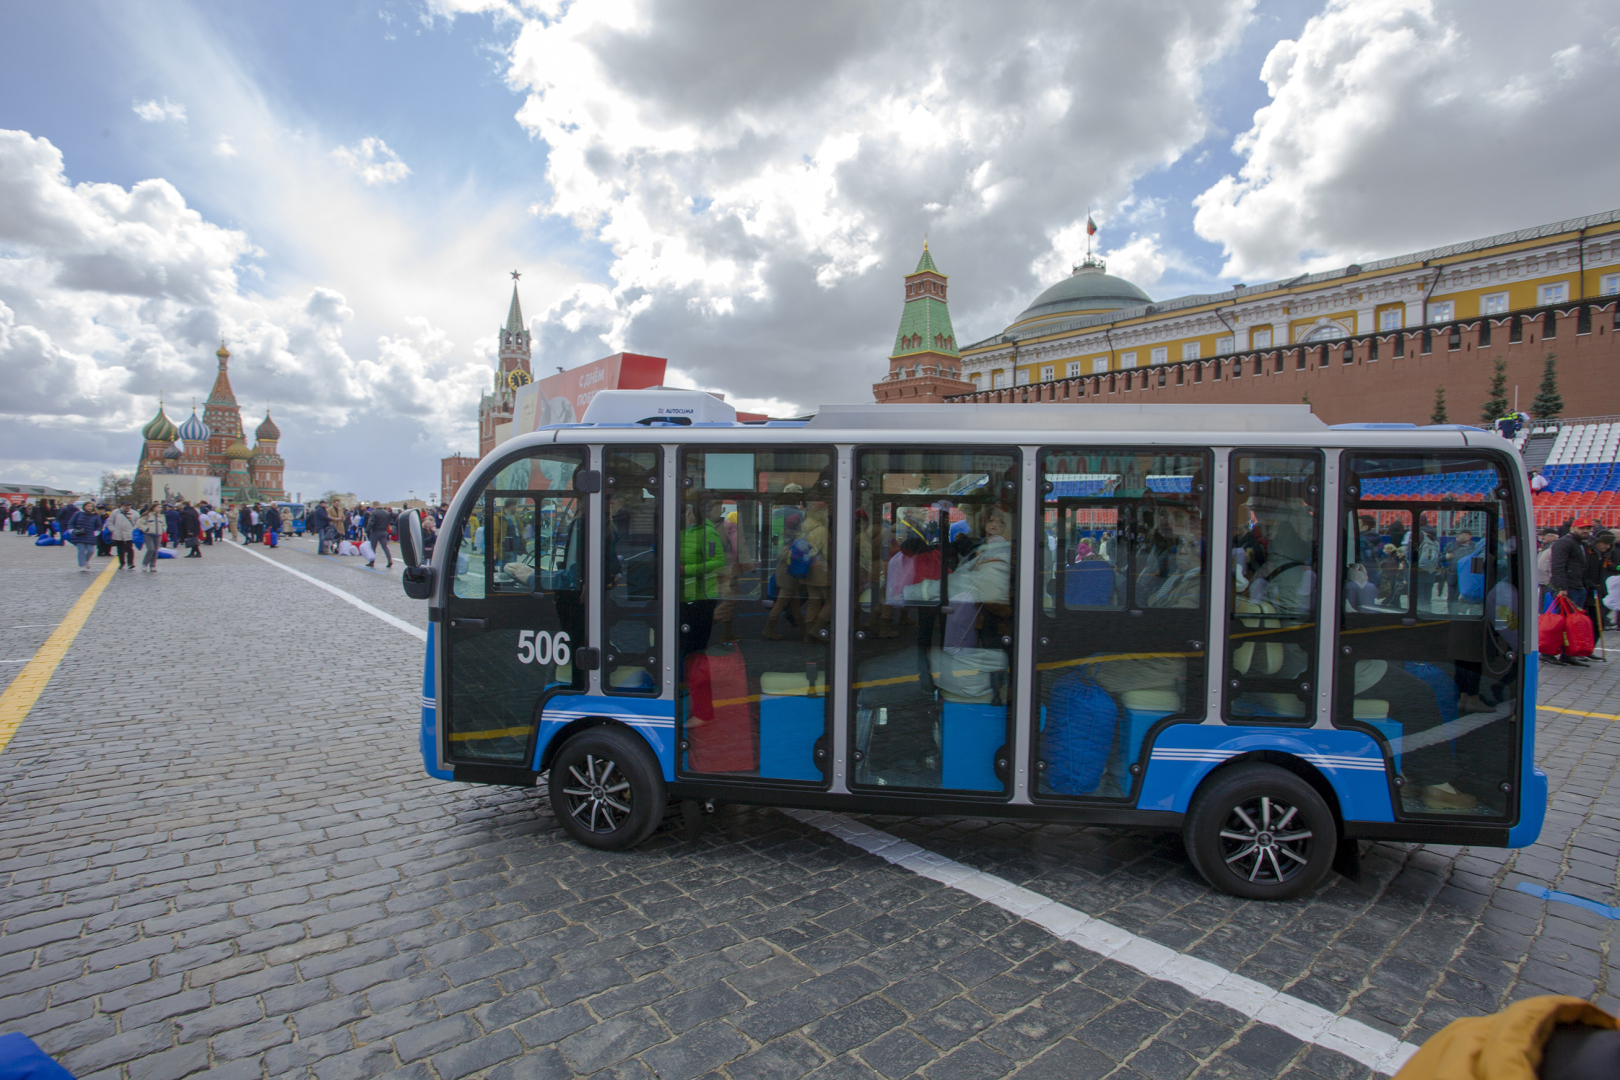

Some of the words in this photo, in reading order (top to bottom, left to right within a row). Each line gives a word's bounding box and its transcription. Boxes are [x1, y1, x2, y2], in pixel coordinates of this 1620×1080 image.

[579, 374, 584, 388] С
[584, 367, 605, 389] ДНЁМ
[517, 629, 571, 666] 506
